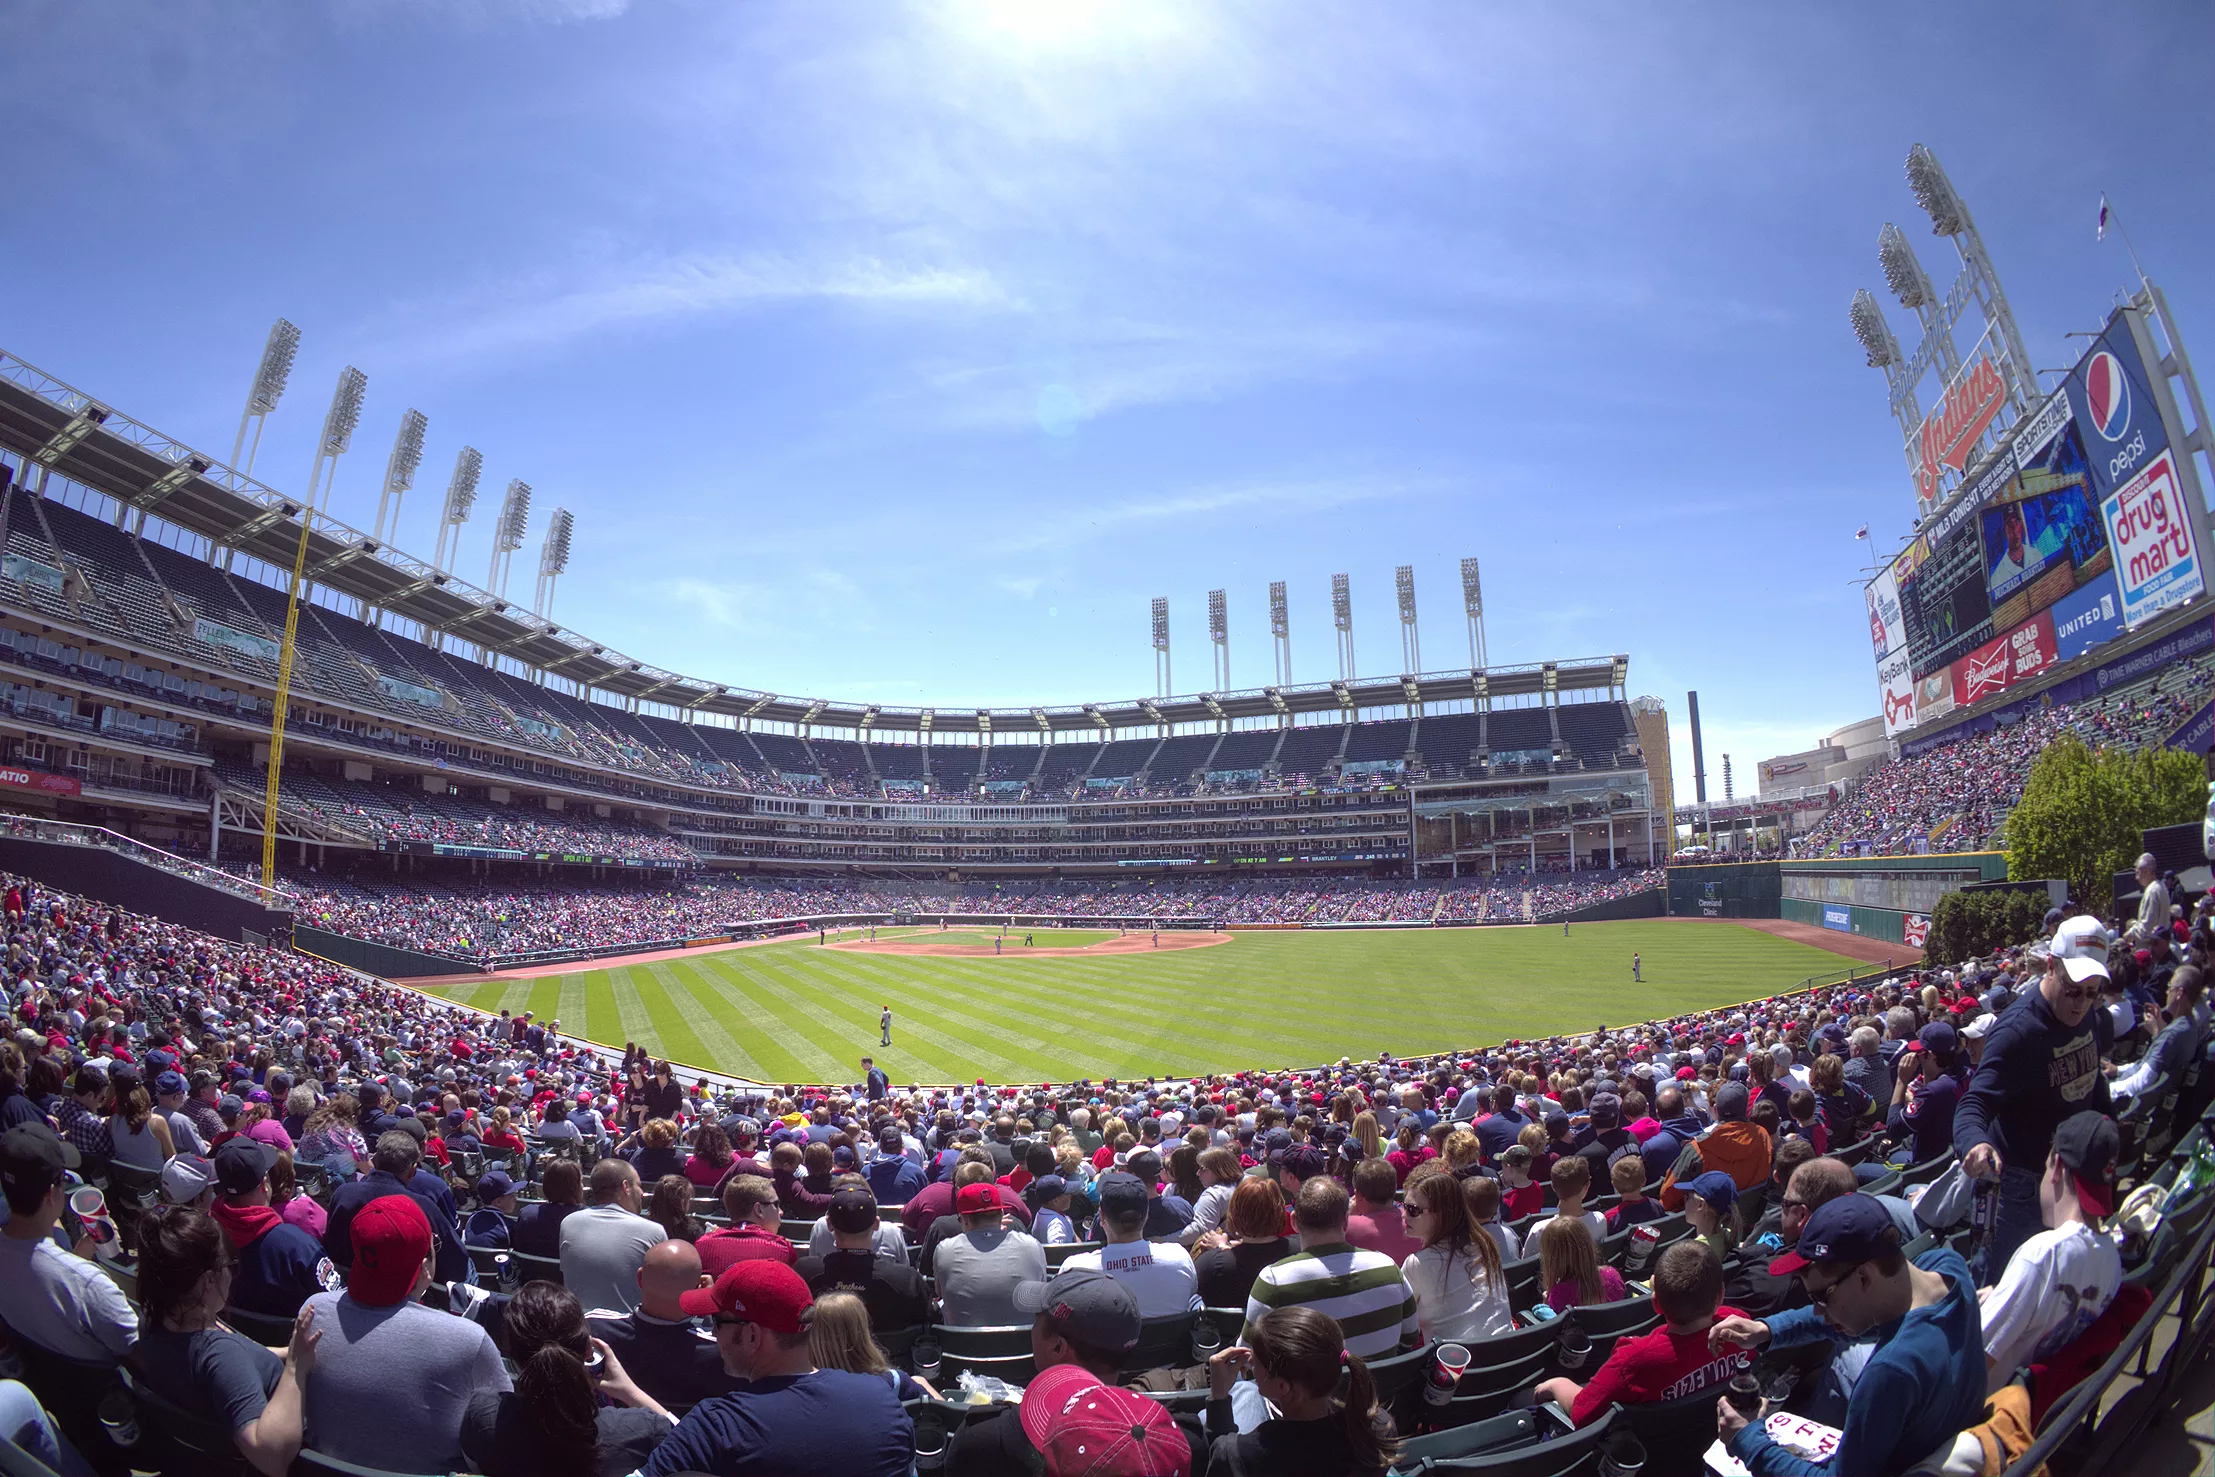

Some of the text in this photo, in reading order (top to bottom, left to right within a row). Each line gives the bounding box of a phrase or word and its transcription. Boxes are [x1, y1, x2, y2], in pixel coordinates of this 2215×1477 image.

[1919, 354, 2005, 500] Indians
[2109, 430, 2147, 483] pepsi
[2122, 474, 2150, 504] DISCOUNT
[1935, 516, 1951, 540] MLB
[1948, 489, 1980, 527] TONIGHT
[2117, 489, 2169, 545] drug
[2130, 522, 2190, 586] mart
[2126, 606, 2143, 622] More
[2142, 600, 2159, 616] than
[2165, 574, 2201, 604] Drugstore
[2143, 571, 2175, 597] FOOD FAIR
[2012, 624, 2039, 649] GRAB
[2058, 607, 2101, 638] UNITED
[2015, 649, 2043, 674] BUDS
[2018, 641, 2036, 656] SOME
[2108, 628, 2213, 681] TIME WARNER CABLE Bleachers
[1880, 656, 1910, 686] KeyBank
[1964, 656, 2010, 689] Budweiser
[2187, 714, 2215, 744] CABLE
[1698, 899, 1722, 907] Cleveland
[1703, 908, 1718, 916] Clinic
[2048, 1052, 2078, 1088] NEW
[360, 1245, 380, 1269] C
[1106, 1255, 1155, 1271] OHIO STATE
